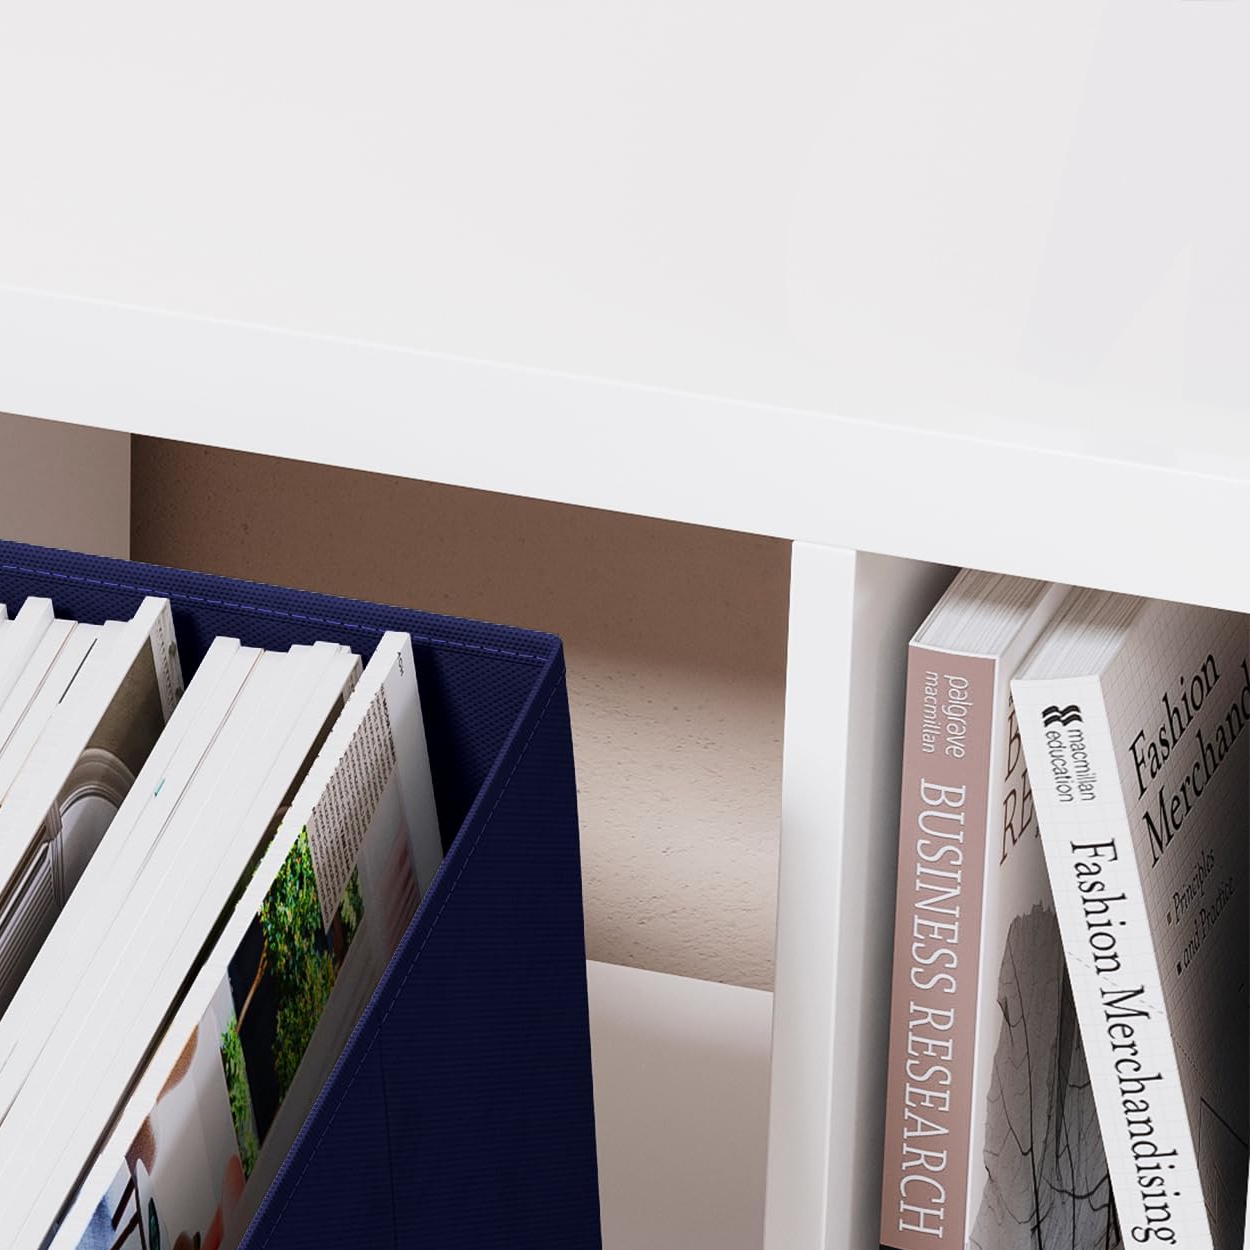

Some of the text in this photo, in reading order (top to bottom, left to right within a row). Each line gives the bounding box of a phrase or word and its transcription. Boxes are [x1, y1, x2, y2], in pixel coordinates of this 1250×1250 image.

[921, 670, 942, 754] macmillan
[941, 673, 974, 760] palgrave
[1128, 652, 1222, 801] Fashion
[1045, 730, 1075, 803] education
[1067, 728, 1097, 801] macmillan
[1172, 847, 1216, 925] Principles
[1181, 877, 1235, 969] and Practice
[897, 777, 967, 1239] BUSINESS RESEARCH
[1070, 837, 1182, 1246] Fashion Merchandising
